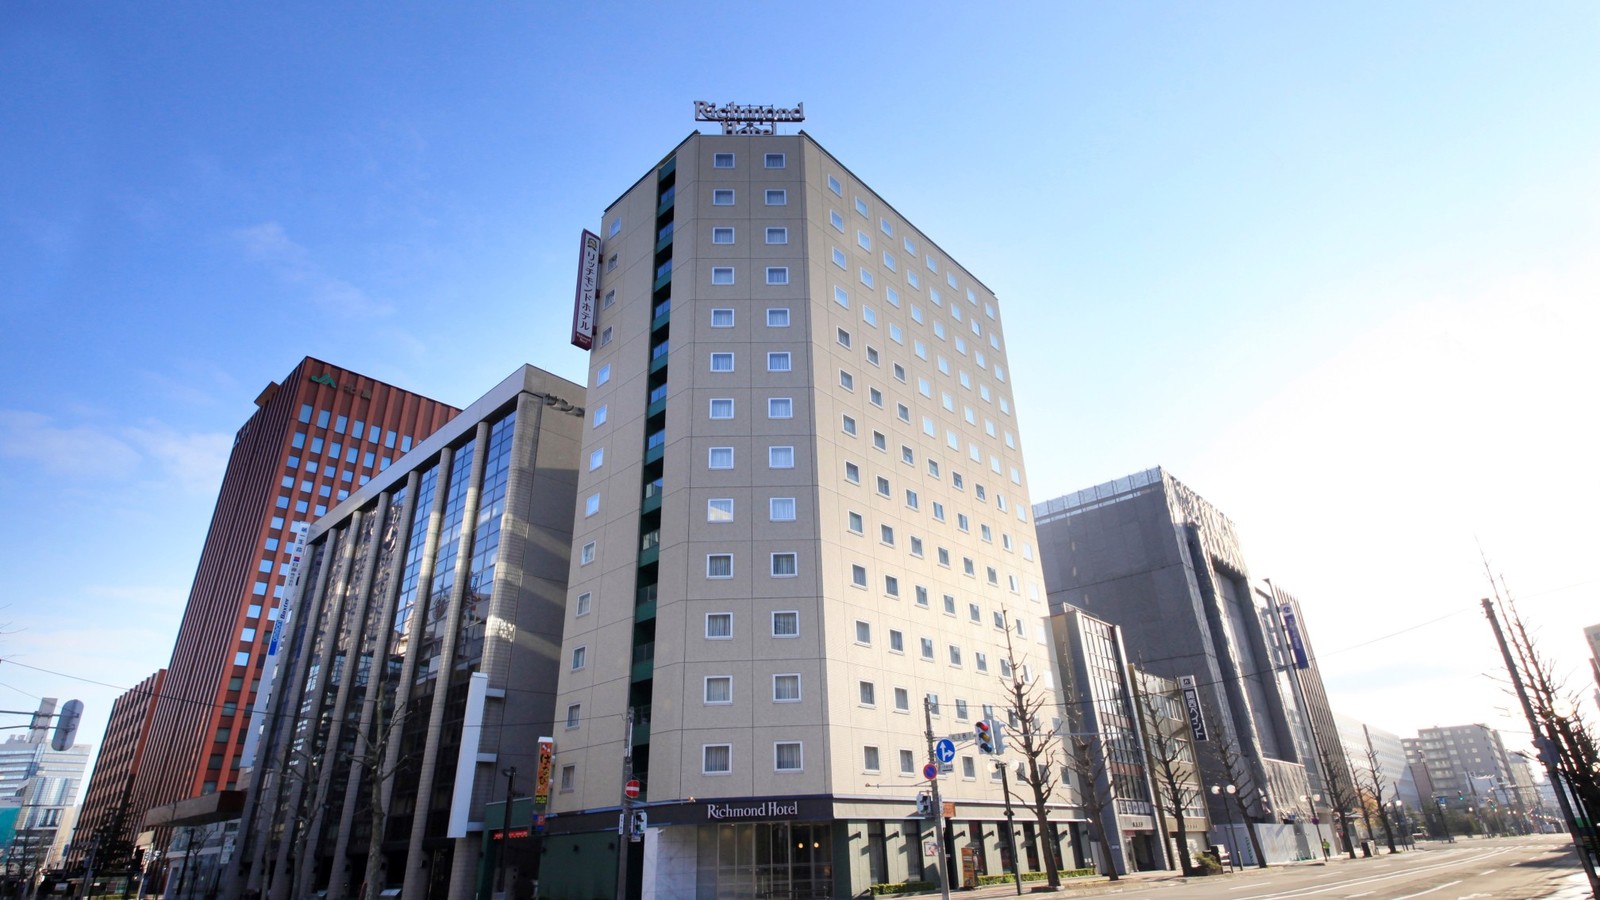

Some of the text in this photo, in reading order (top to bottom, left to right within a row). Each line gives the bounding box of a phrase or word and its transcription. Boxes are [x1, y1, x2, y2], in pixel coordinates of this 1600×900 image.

[694, 100, 805, 121] Richmond
[580, 251, 596, 331] リッチモンドホテル
[707, 801, 798, 819] Richmond Hotel
